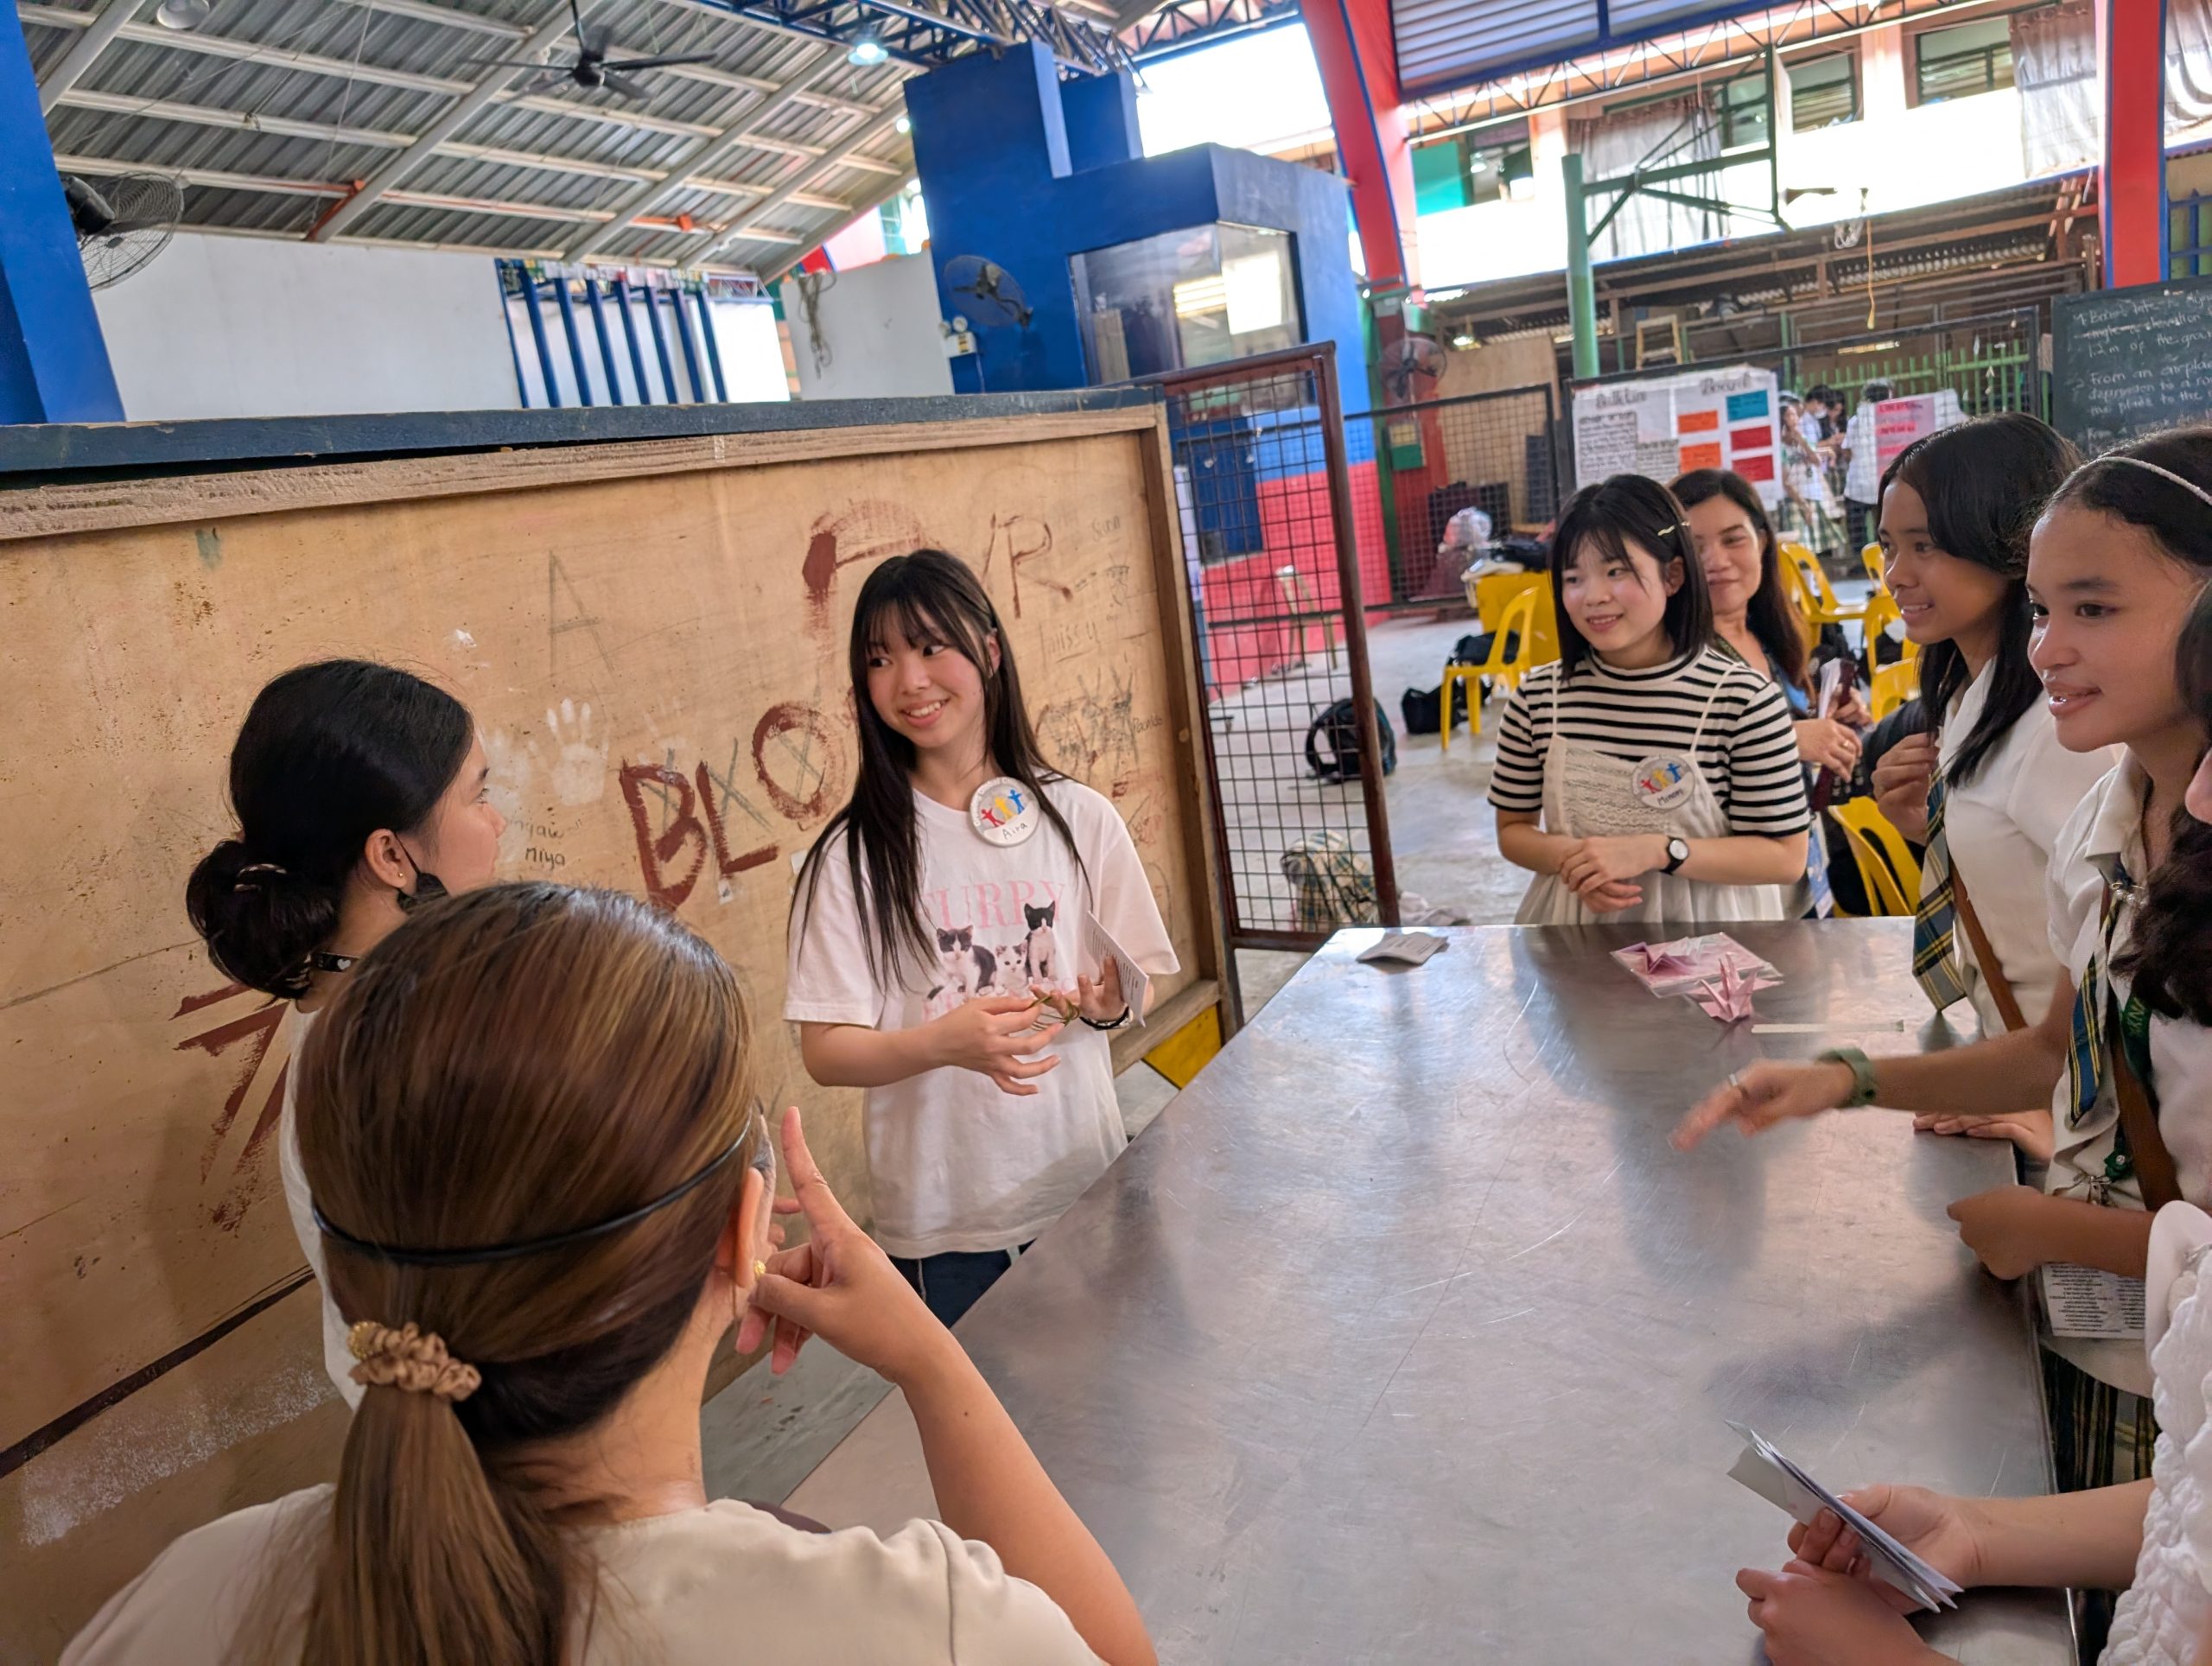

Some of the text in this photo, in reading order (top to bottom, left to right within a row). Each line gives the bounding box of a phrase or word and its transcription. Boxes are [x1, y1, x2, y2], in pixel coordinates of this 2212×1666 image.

[2089, 372, 2126, 385] From
[2133, 369, 2153, 378] an
[1002, 822, 1028, 840] Aira
[922, 880, 1065, 931] URRY
